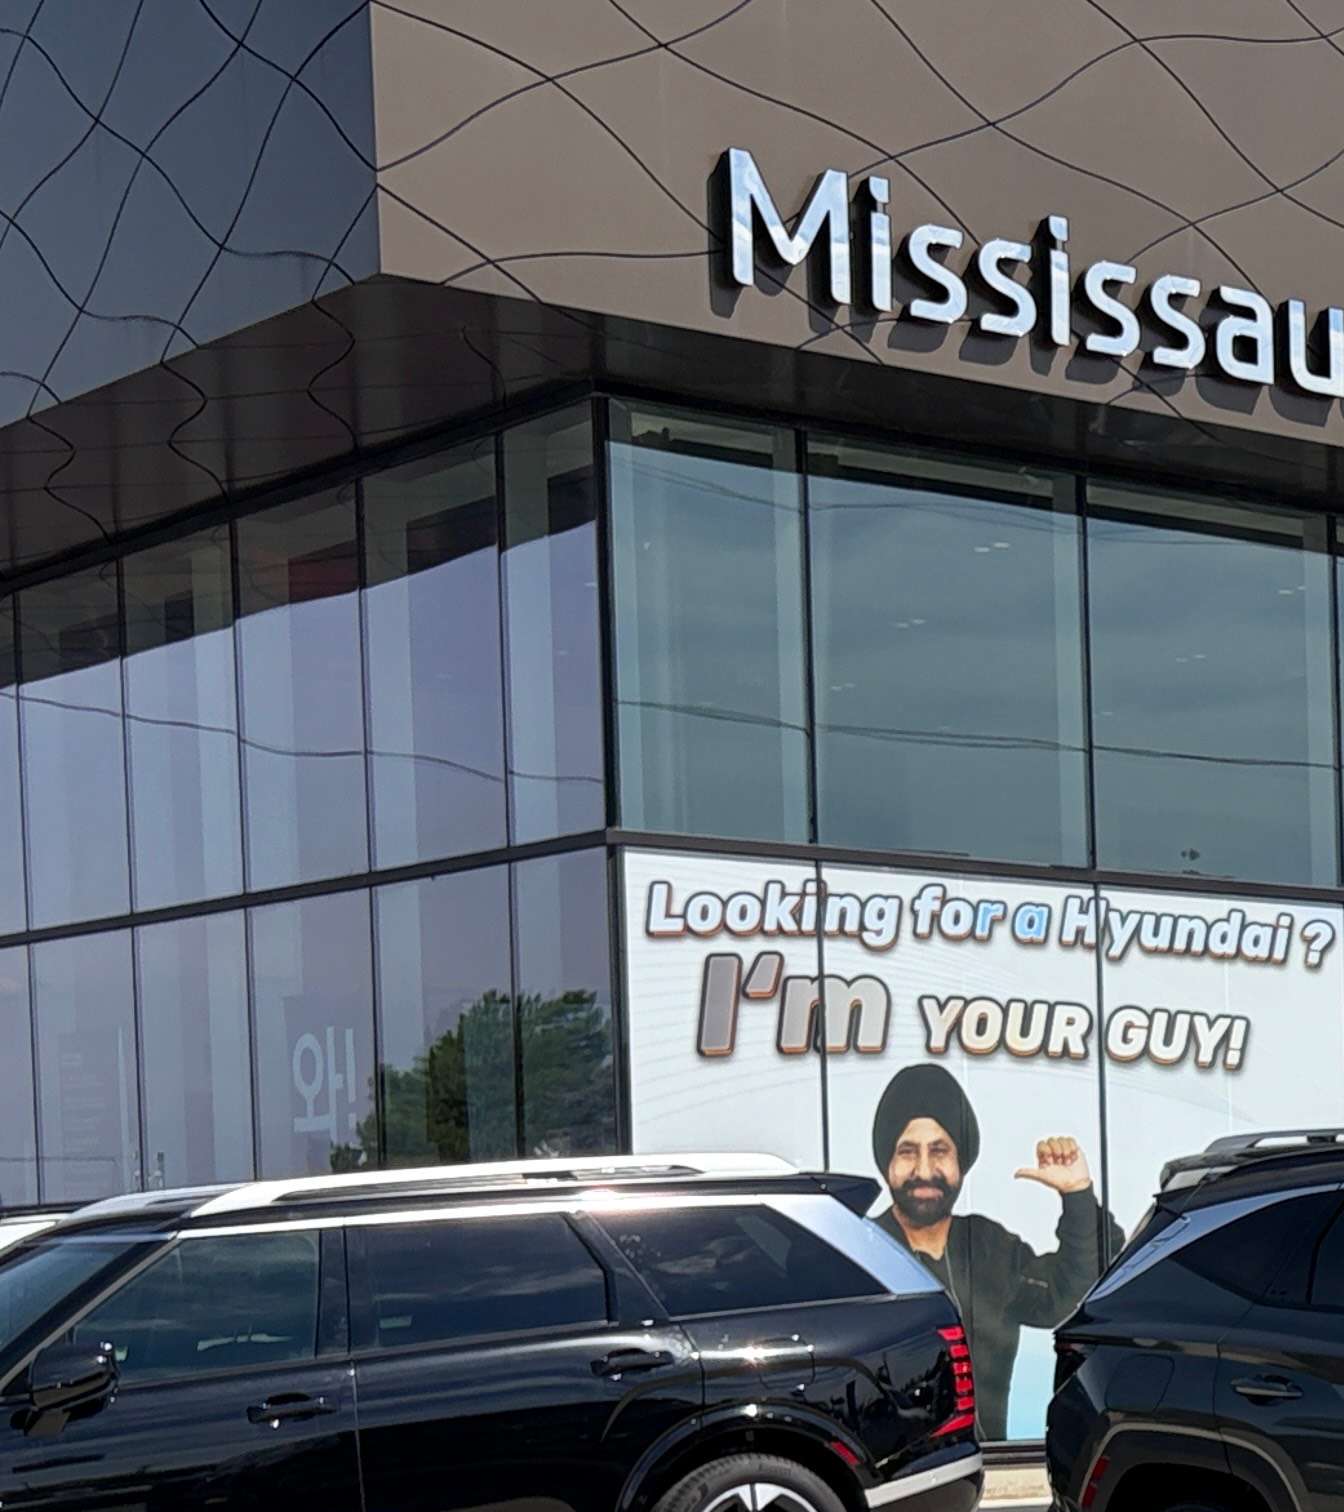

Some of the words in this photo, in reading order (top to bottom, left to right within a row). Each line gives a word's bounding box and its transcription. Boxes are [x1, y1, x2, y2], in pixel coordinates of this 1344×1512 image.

[645, 879, 899, 952] Looking
[911, 882, 1002, 943] for
[1012, 902, 1049, 943] a
[1059, 895, 1295, 965] Hyundai
[1301, 920, 1336, 969] ?
[697, 950, 893, 1058] I'm
[917, 995, 1093, 1061] YOUR
[1106, 1006, 1252, 1071] GUY!
